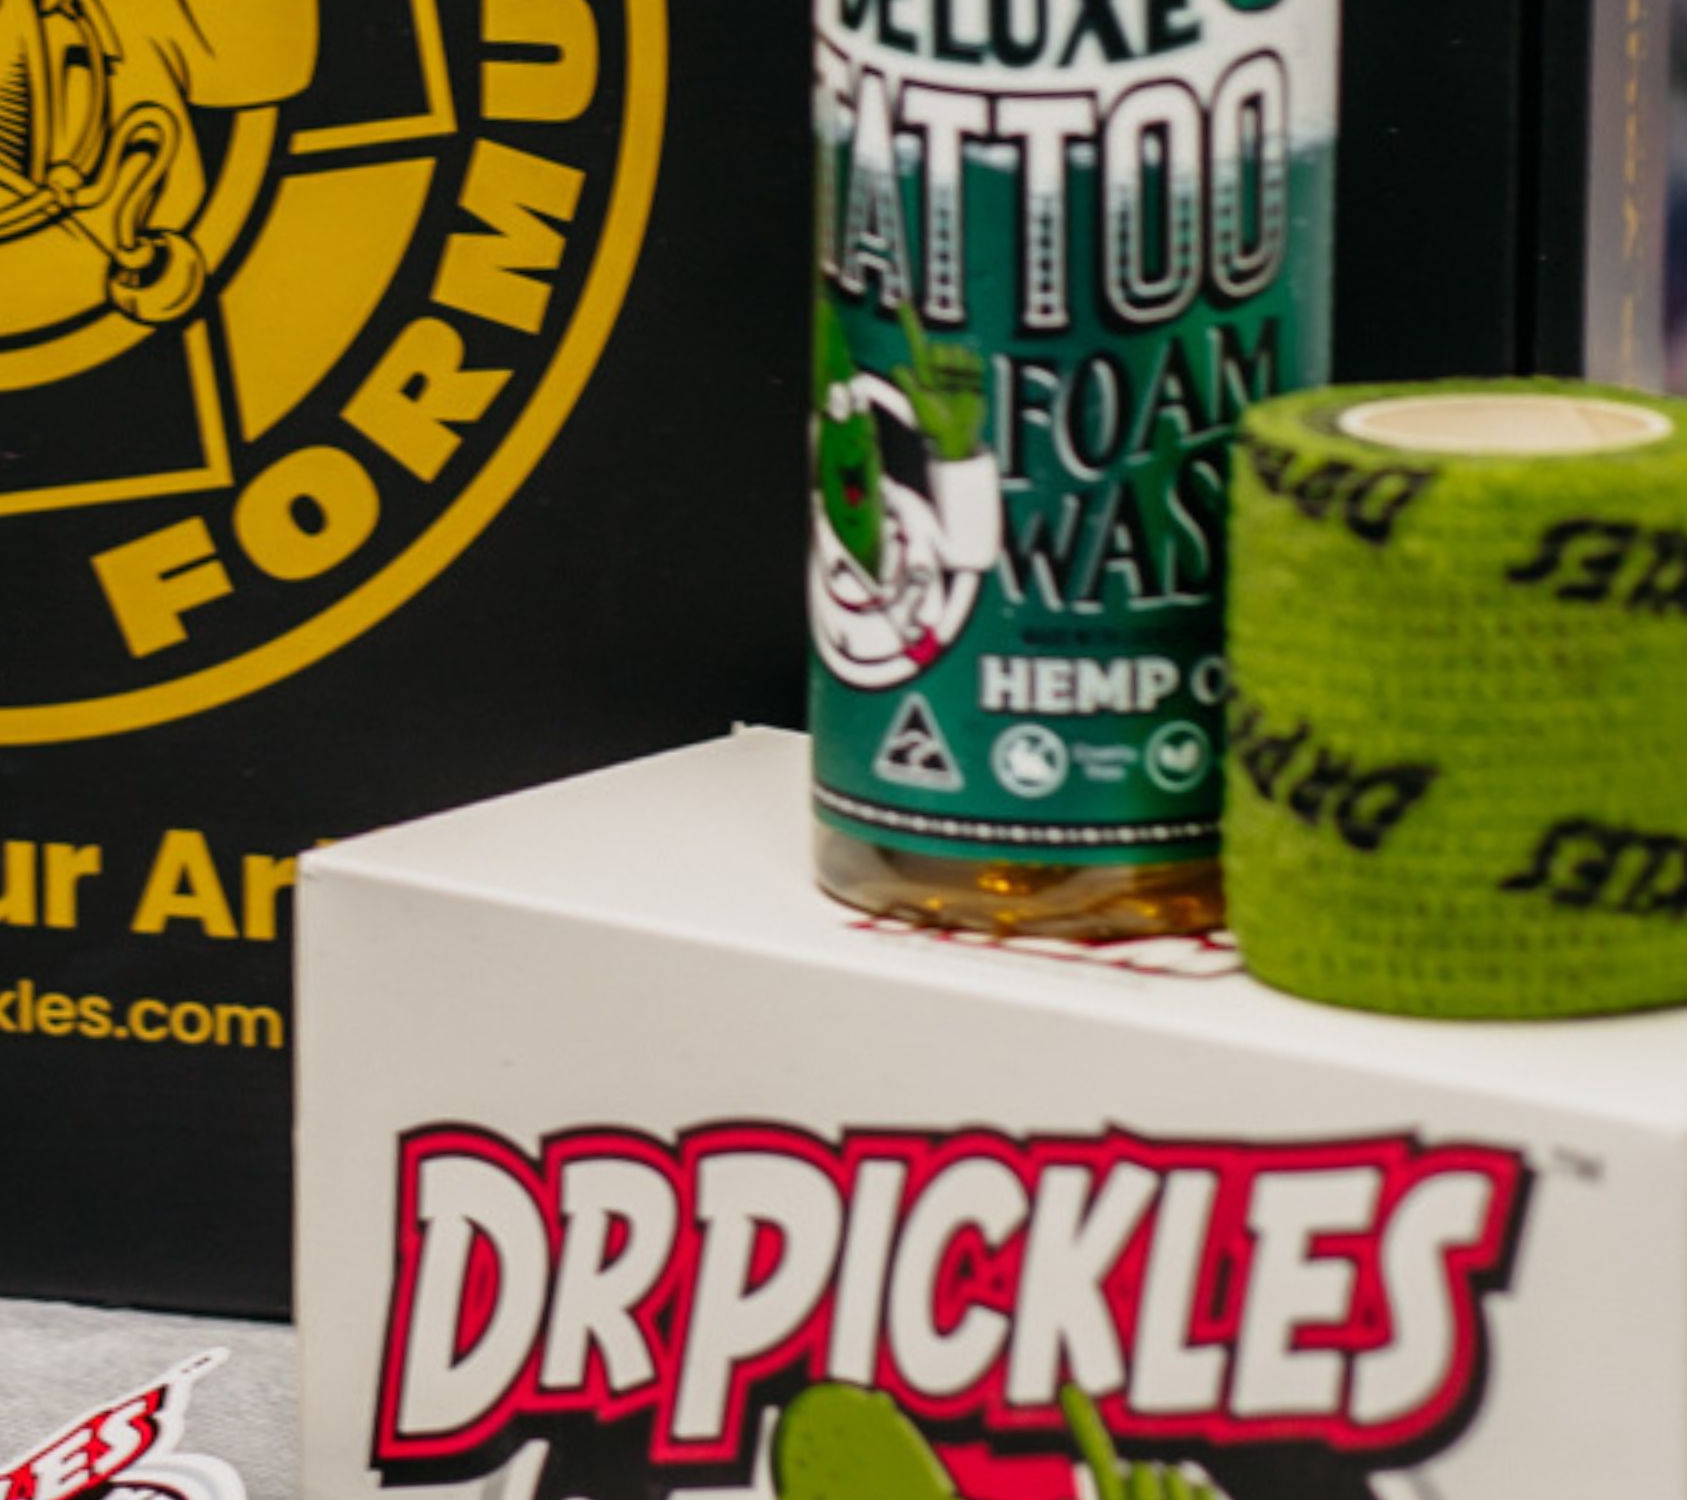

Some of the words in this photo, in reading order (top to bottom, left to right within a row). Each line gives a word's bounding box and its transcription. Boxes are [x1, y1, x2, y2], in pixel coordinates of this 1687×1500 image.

[991, 317, 1281, 492] FOAM
[995, 452, 1231, 614] WAS
[979, 653, 1180, 715] HEMP
[130, 828, 297, 942] Ar
